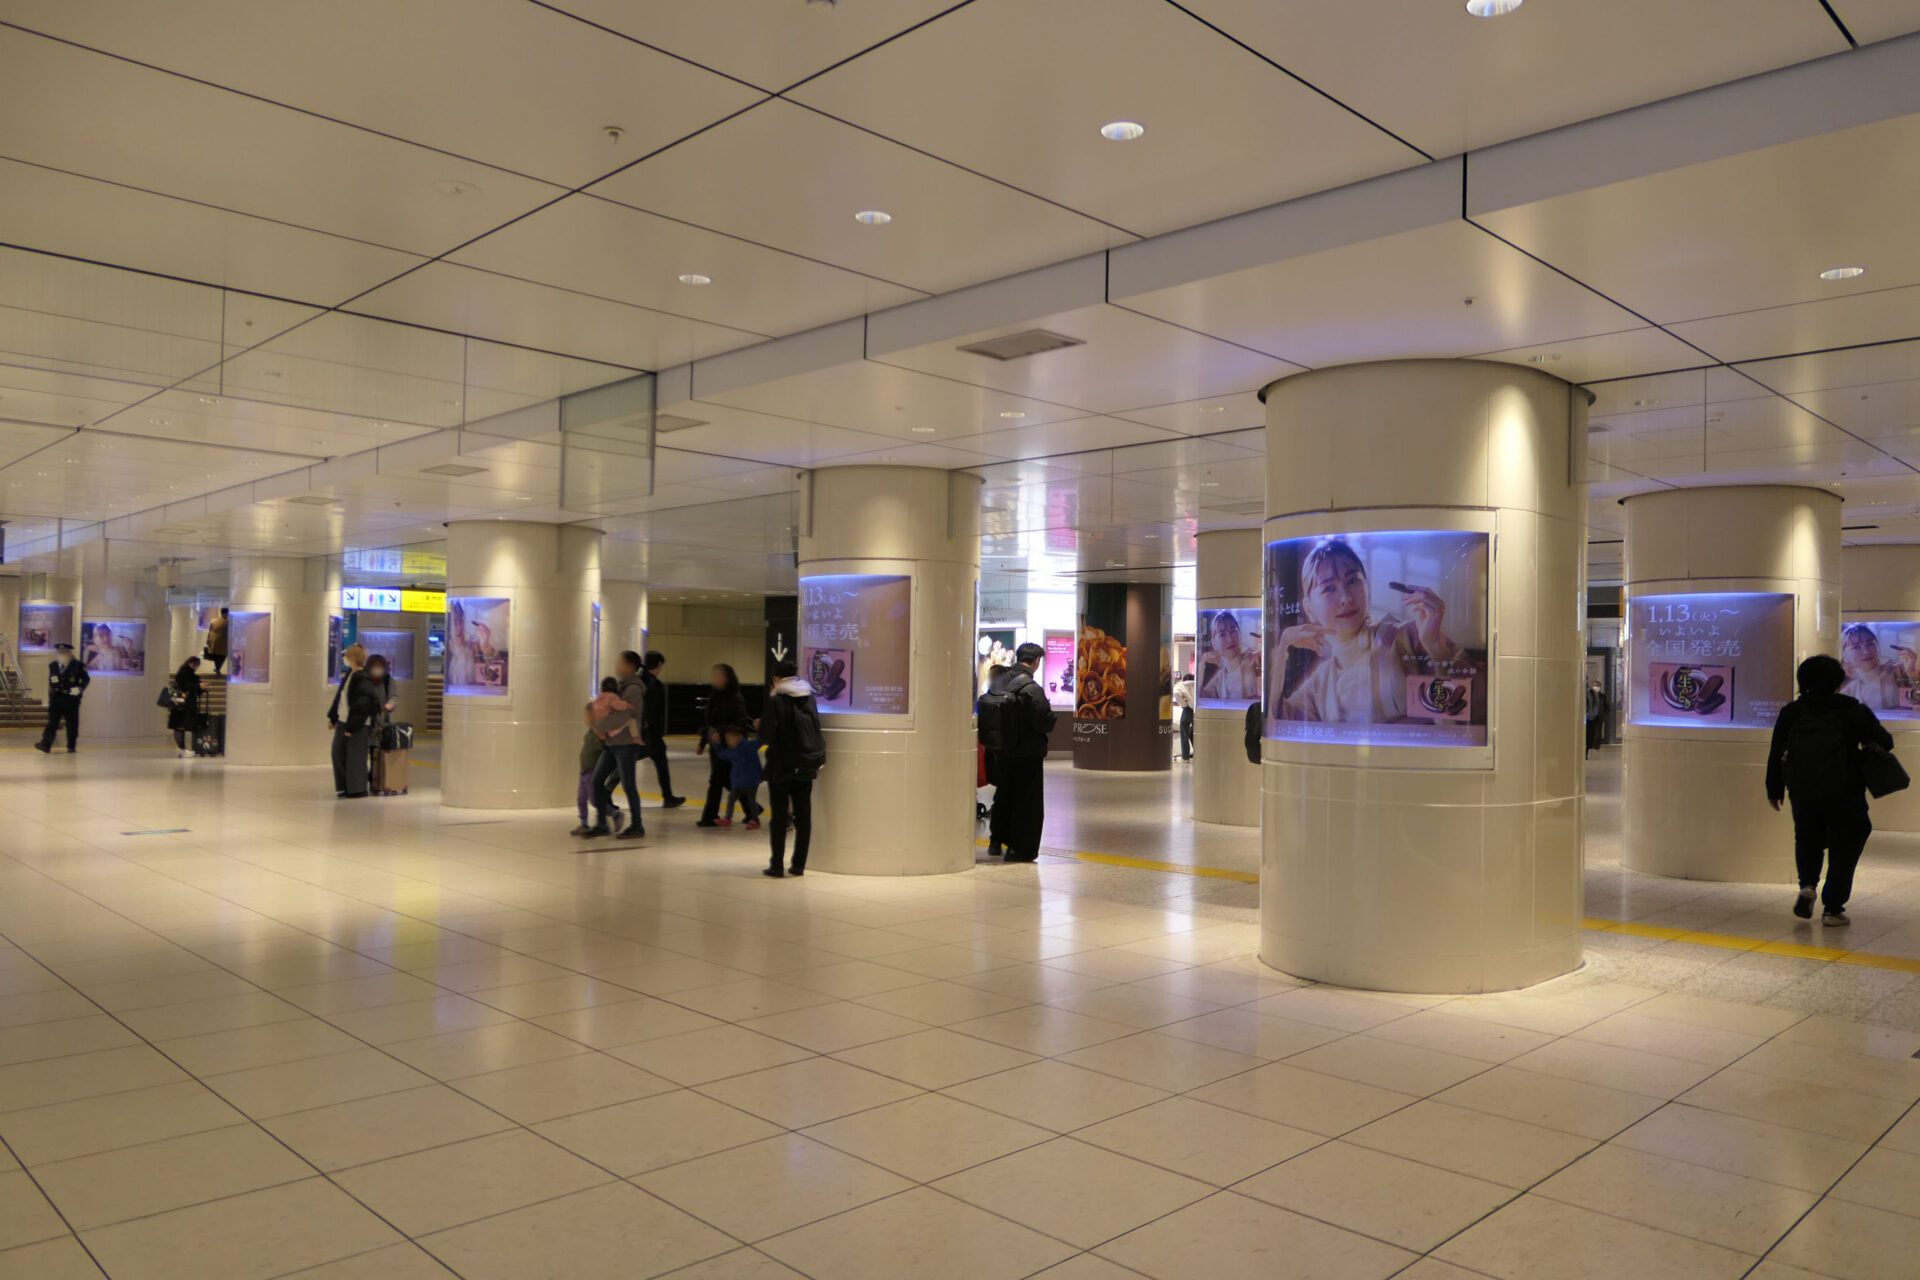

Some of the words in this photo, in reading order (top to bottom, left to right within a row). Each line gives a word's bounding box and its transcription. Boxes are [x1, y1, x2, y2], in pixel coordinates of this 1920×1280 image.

[803, 622, 859, 641] 国発売
[1659, 625, 1721, 637] いよいよ
[1647, 639, 1741, 657] 全国発売
